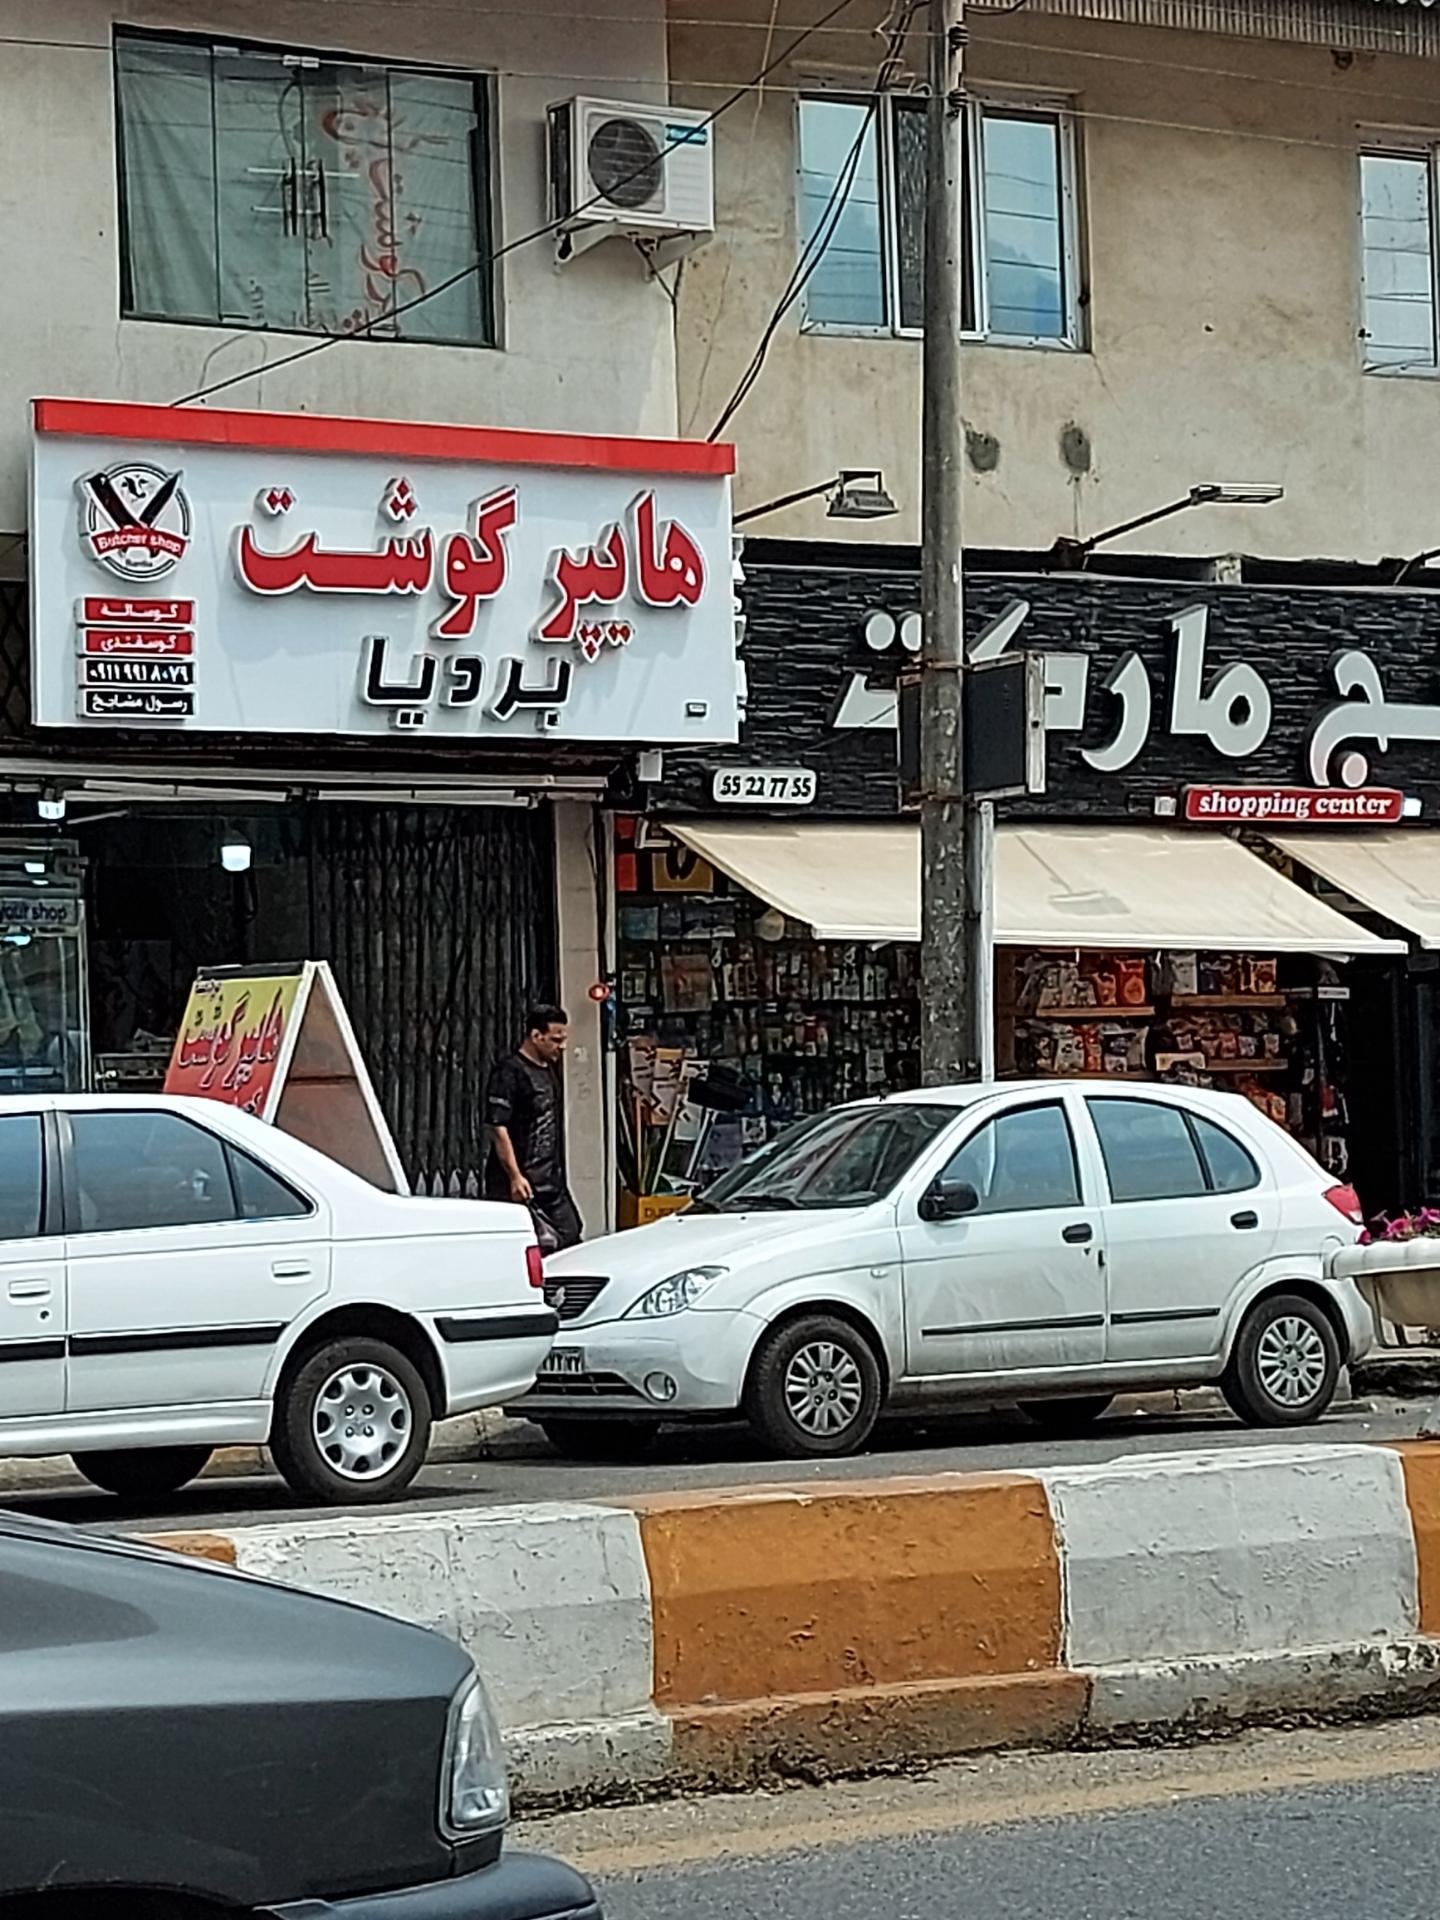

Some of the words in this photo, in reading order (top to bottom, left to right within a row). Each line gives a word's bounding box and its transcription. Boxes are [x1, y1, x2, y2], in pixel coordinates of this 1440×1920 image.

[96, 533, 147, 550] Butcher
[238, 477, 518, 637] گوشت
[538, 492, 706, 659] هایپر
[100, 603, 178, 622] گوساله
[100, 634, 177, 653] گوسفندی
[361, 637, 573, 729] بردیا
[145, 694, 188, 713] رسول
[1199, 791, 1312, 818] shopping
[1315, 793, 1393, 815] center
[32, 901, 68, 925] shop
